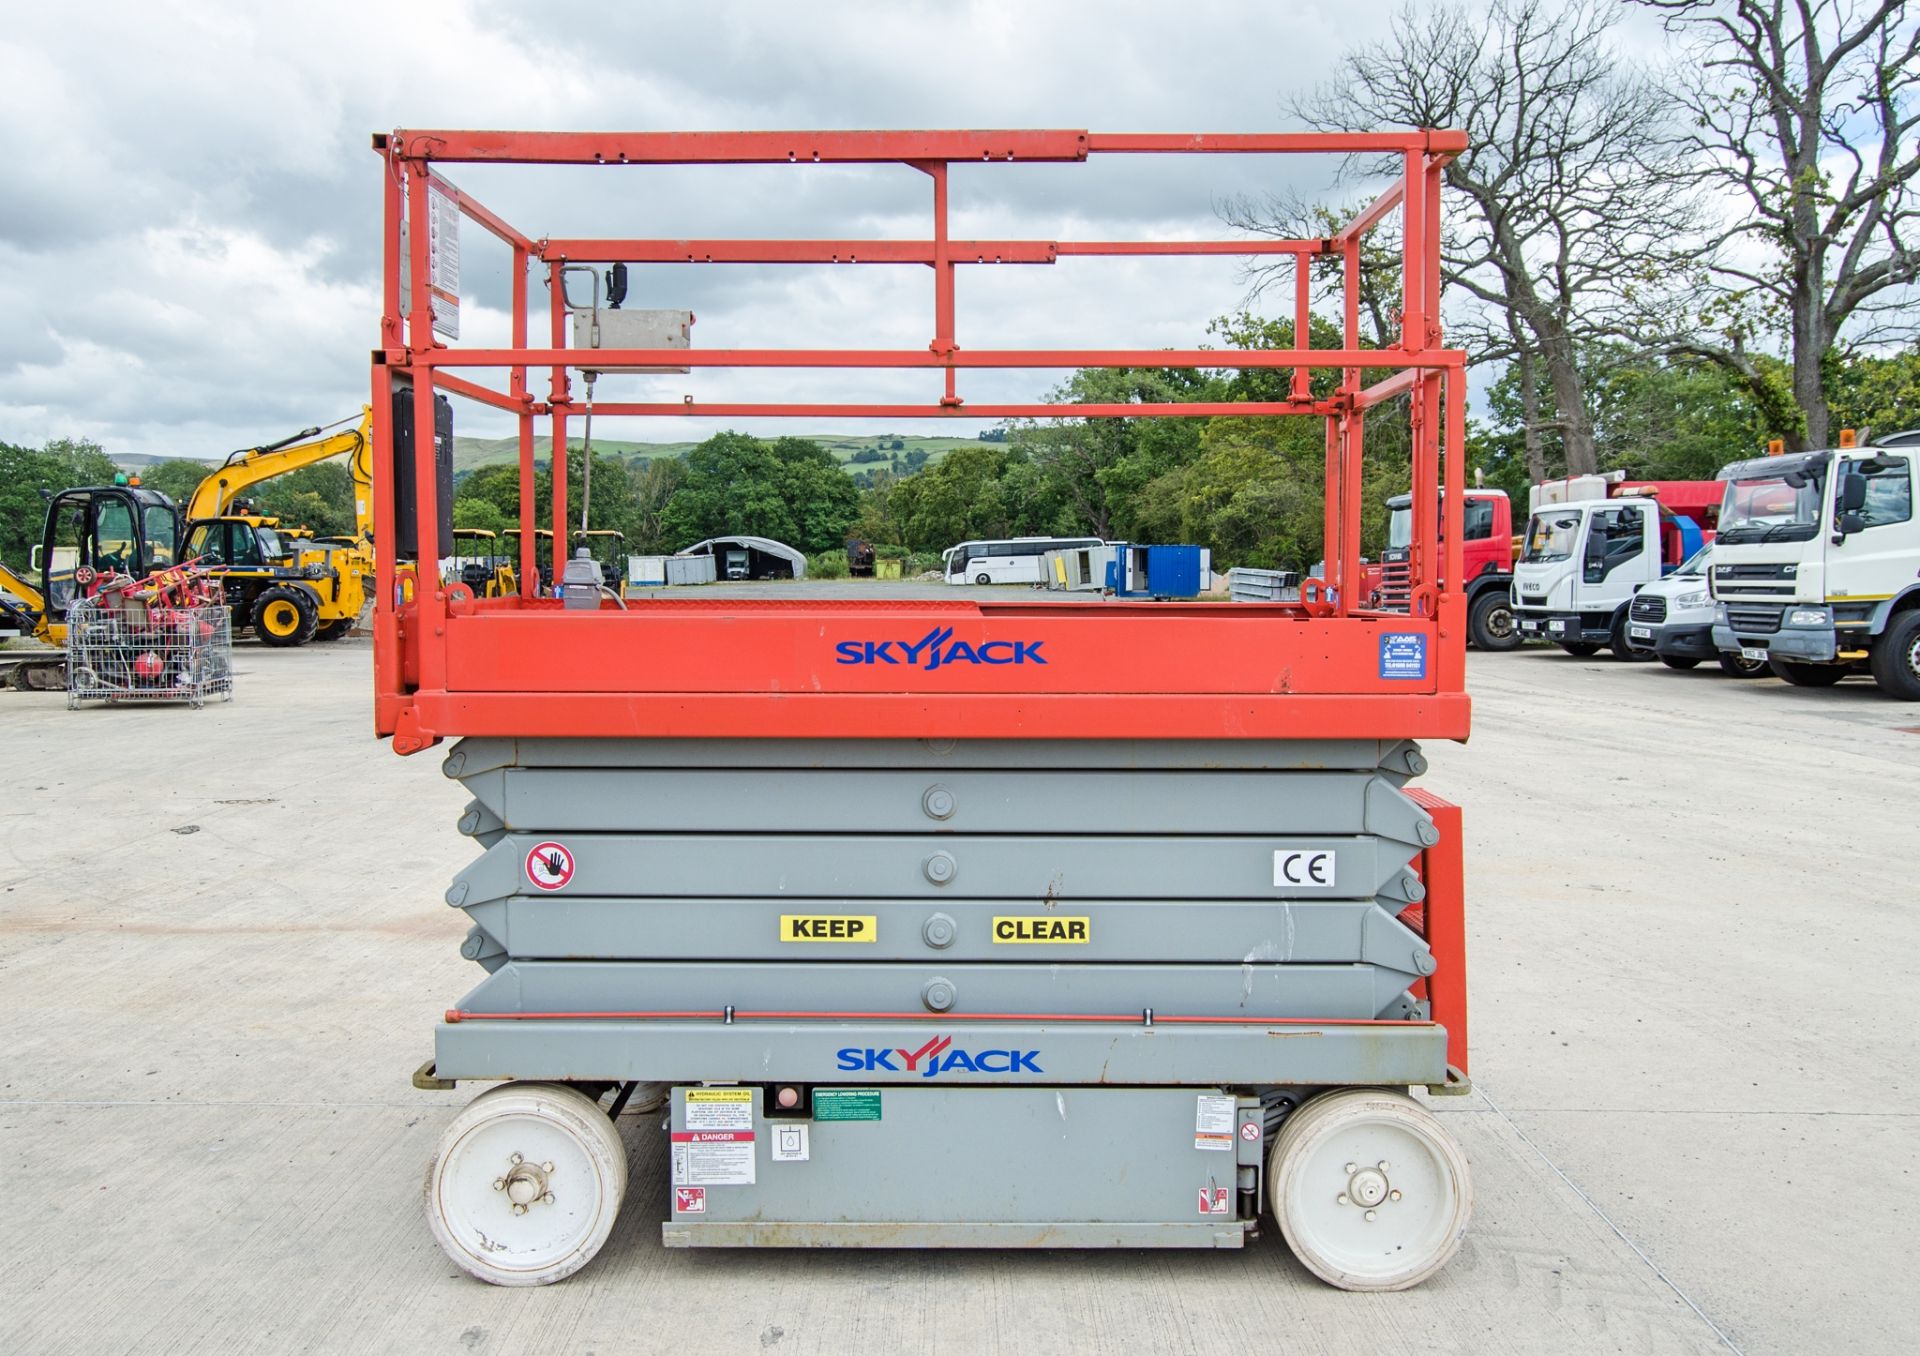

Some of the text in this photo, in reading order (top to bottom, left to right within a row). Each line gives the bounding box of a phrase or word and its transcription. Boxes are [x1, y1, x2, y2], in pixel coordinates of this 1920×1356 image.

[1522, 582, 1540, 591] IVECO
[836, 626, 1049, 671] SKYJACK
[1283, 854, 1327, 883] CE
[792, 919, 864, 938] KEEP
[996, 920, 1087, 940] CLEAR
[836, 1034, 1044, 1078] SKYJACK
[701, 1133, 735, 1141] DANGER
